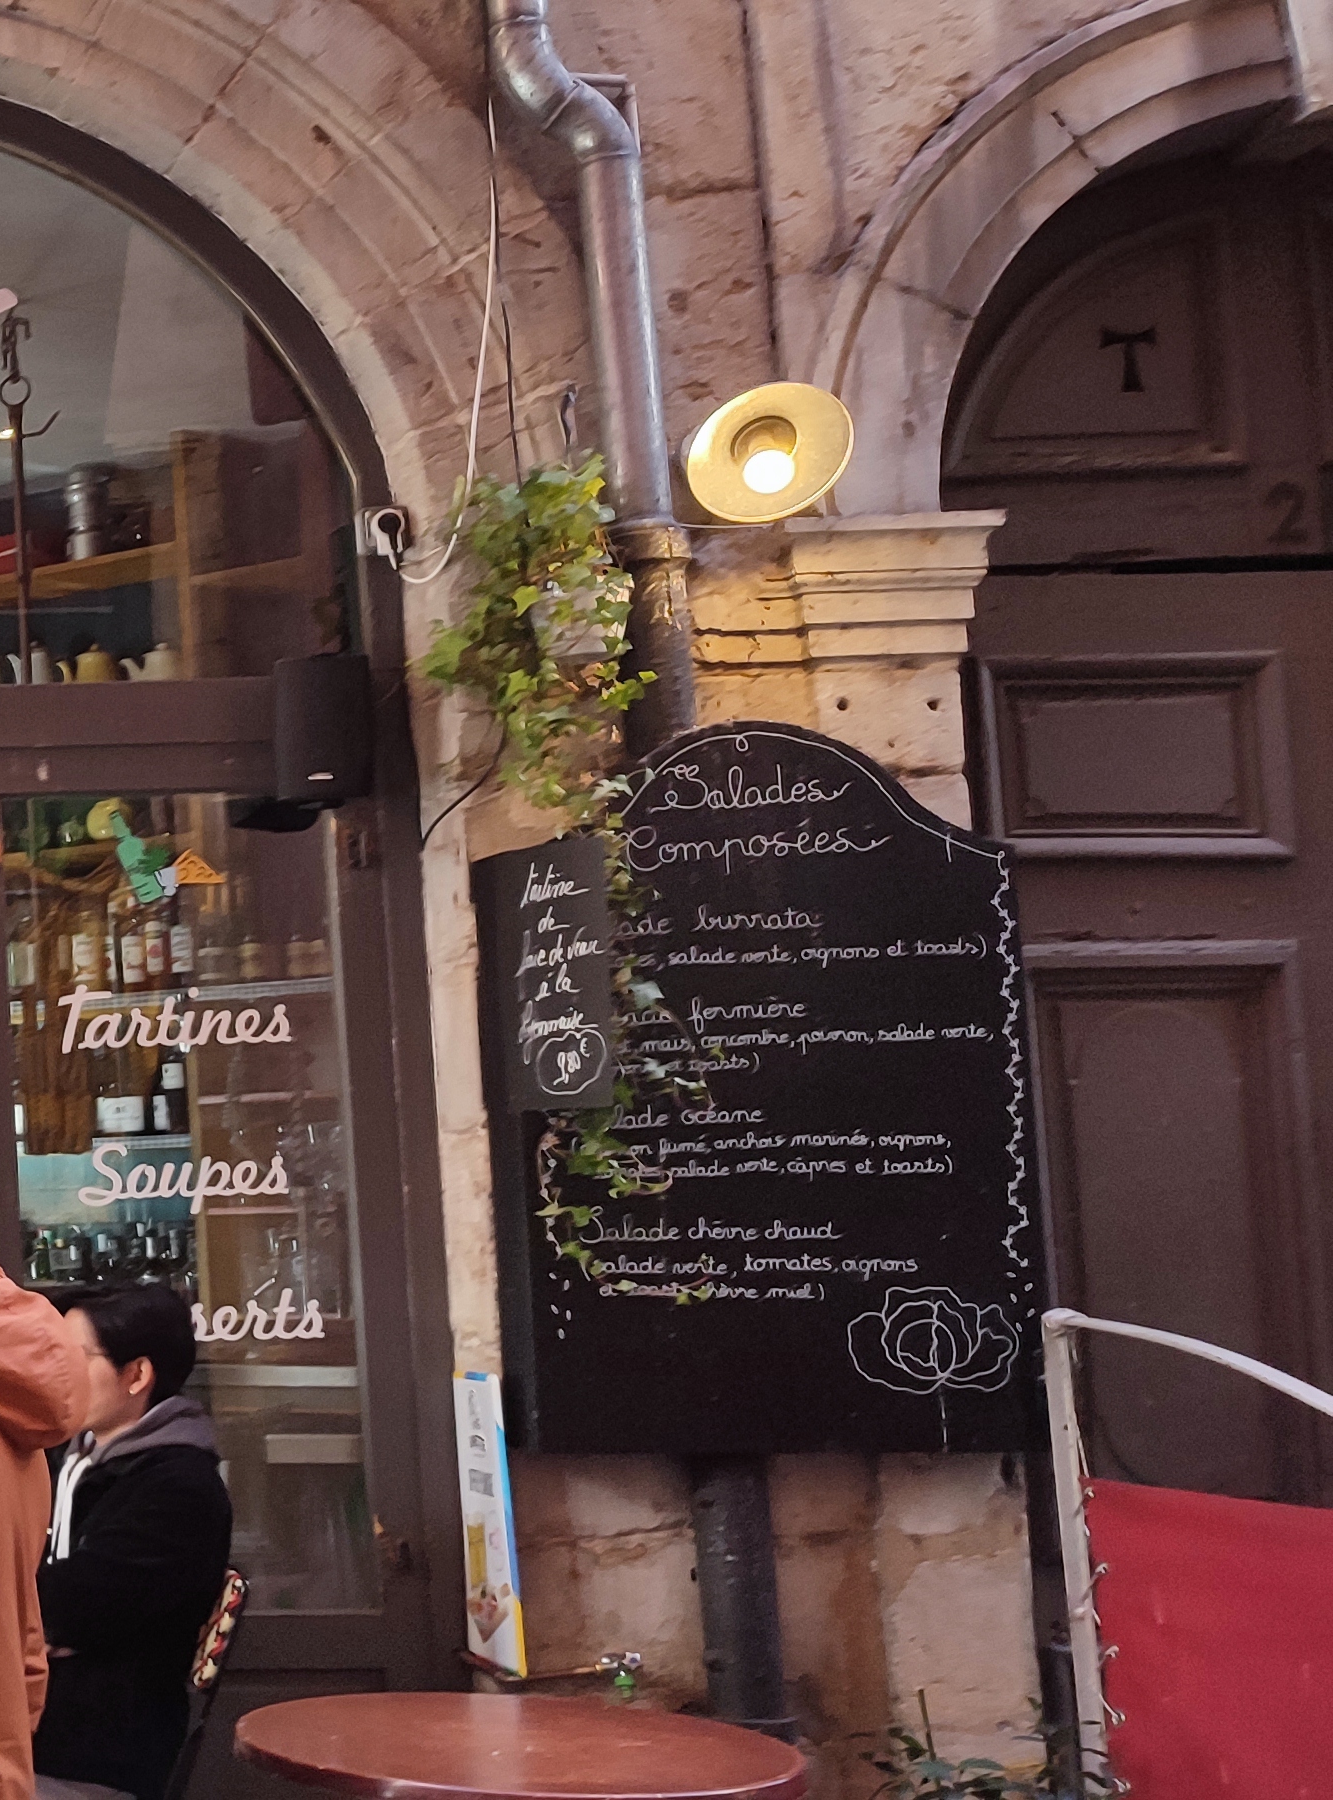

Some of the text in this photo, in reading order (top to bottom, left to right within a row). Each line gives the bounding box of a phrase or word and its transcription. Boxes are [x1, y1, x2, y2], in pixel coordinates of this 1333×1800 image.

[650, 764, 853, 812] Salades
[621, 819, 891, 875] Composées
[691, 903, 824, 934] burrata
[58, 984, 292, 1054] Tartines
[610, 1103, 671, 1130] lade
[78, 1142, 290, 1214] Soupes
[855, 1157, 876, 1175] et
[579, 1205, 682, 1244] Salade
[764, 1219, 845, 1241] chaud
[192, 1286, 326, 1343] serts
